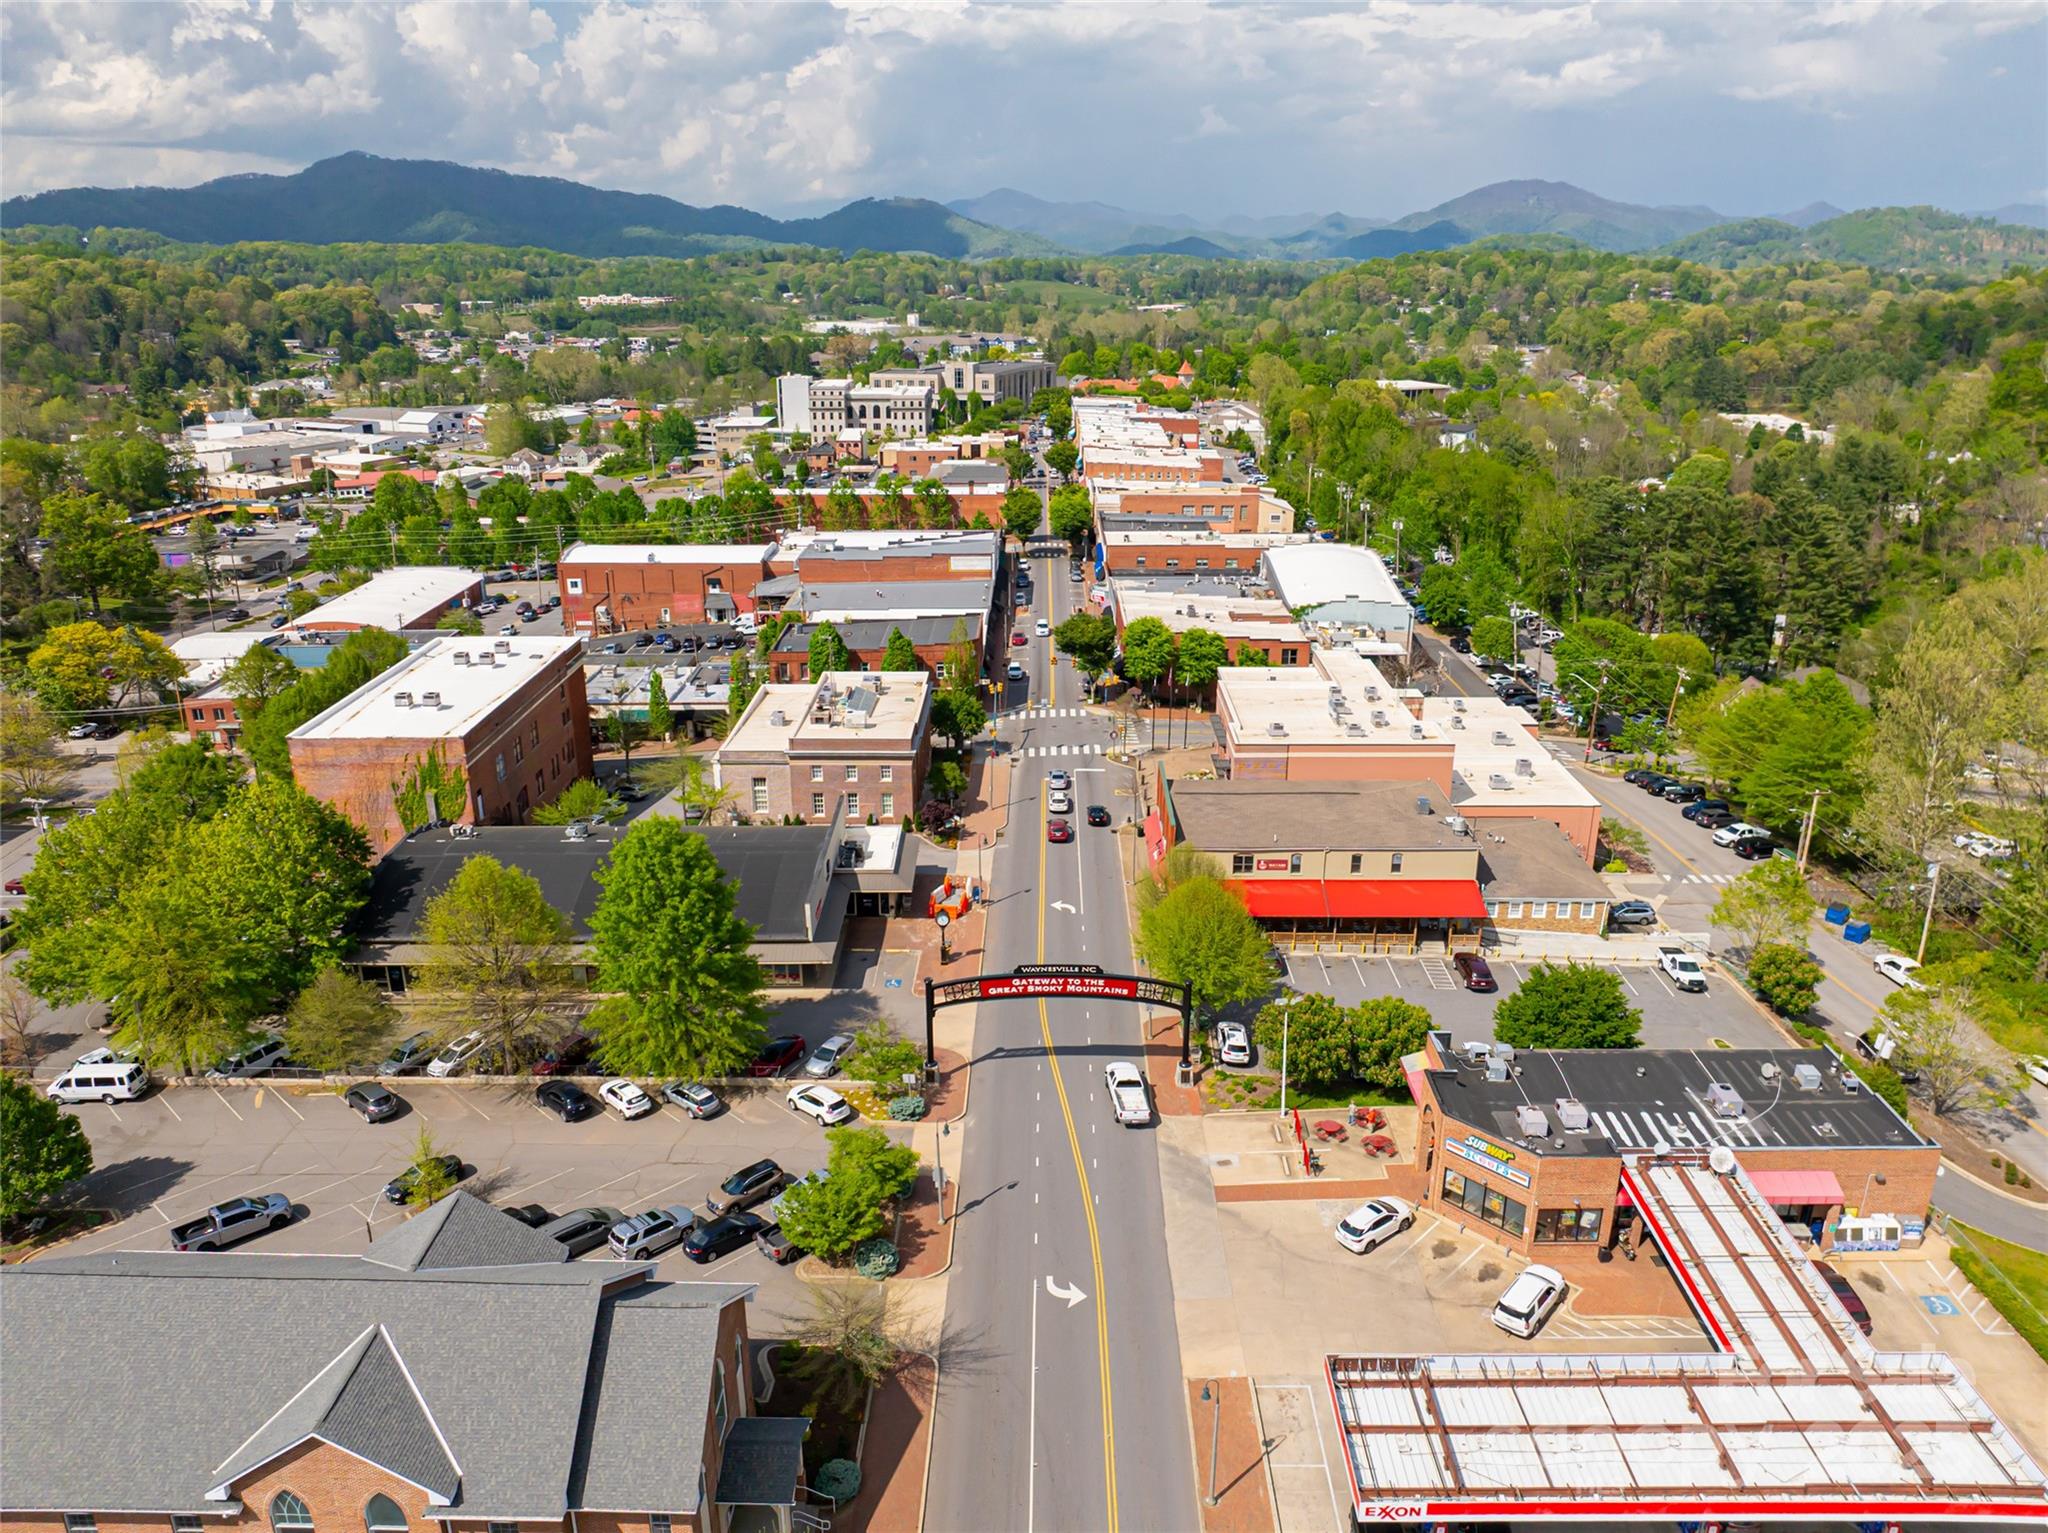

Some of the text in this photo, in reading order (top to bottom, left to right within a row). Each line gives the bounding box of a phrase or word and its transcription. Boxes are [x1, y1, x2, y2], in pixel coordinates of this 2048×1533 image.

[1012, 978, 1064, 986] GATEWAY
[988, 985, 1128, 995] GREAT SMOKY MOUNTAINS
[1465, 1136, 1514, 1163] SUBWAY
[1365, 1505, 1421, 1520] EXXON
